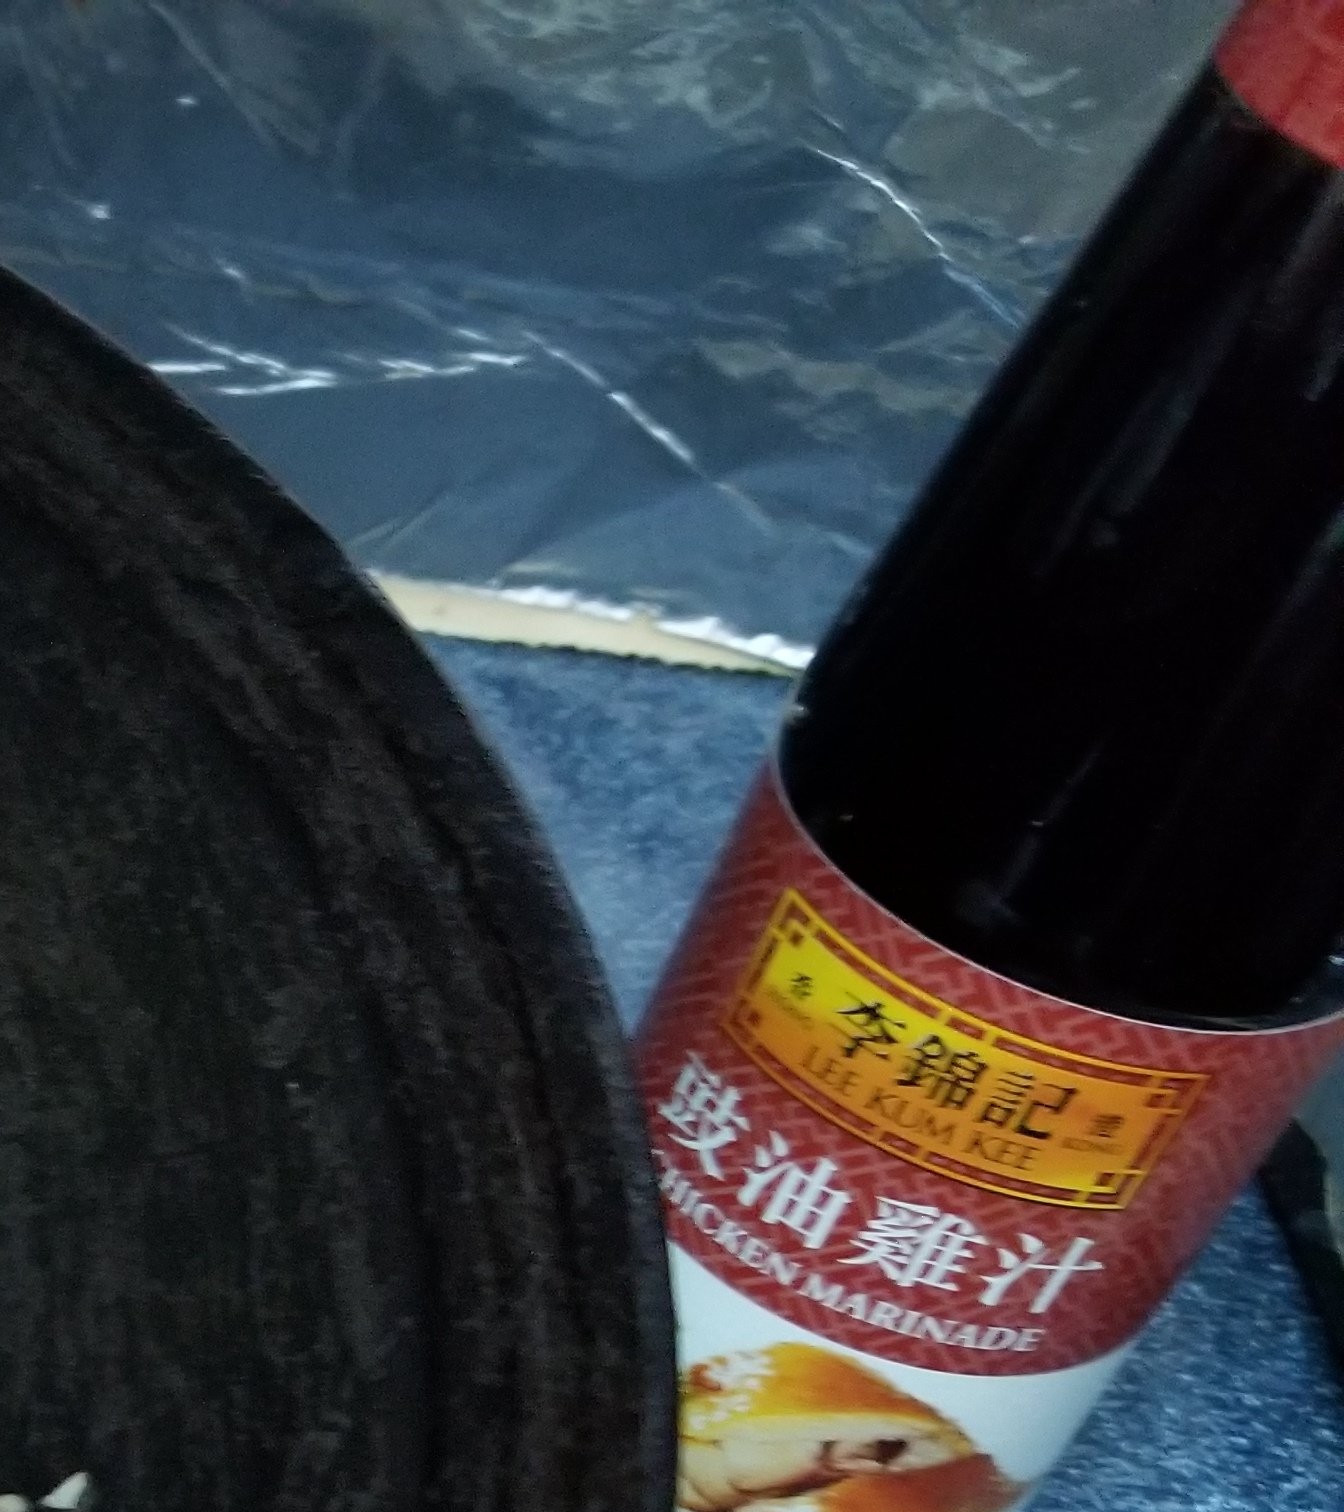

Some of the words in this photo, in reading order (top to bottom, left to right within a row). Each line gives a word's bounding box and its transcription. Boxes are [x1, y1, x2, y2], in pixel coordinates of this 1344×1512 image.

[799, 1046, 861, 1097] LEE
[863, 1090, 959, 1146] KUM
[962, 1130, 1040, 1170] KEE
[838, 992, 1078, 1139] 李錦記
[651, 1149, 804, 1285] HICKEN
[800, 1273, 1045, 1352] MARINADE
[658, 1050, 1105, 1313] 豉油雞汁
